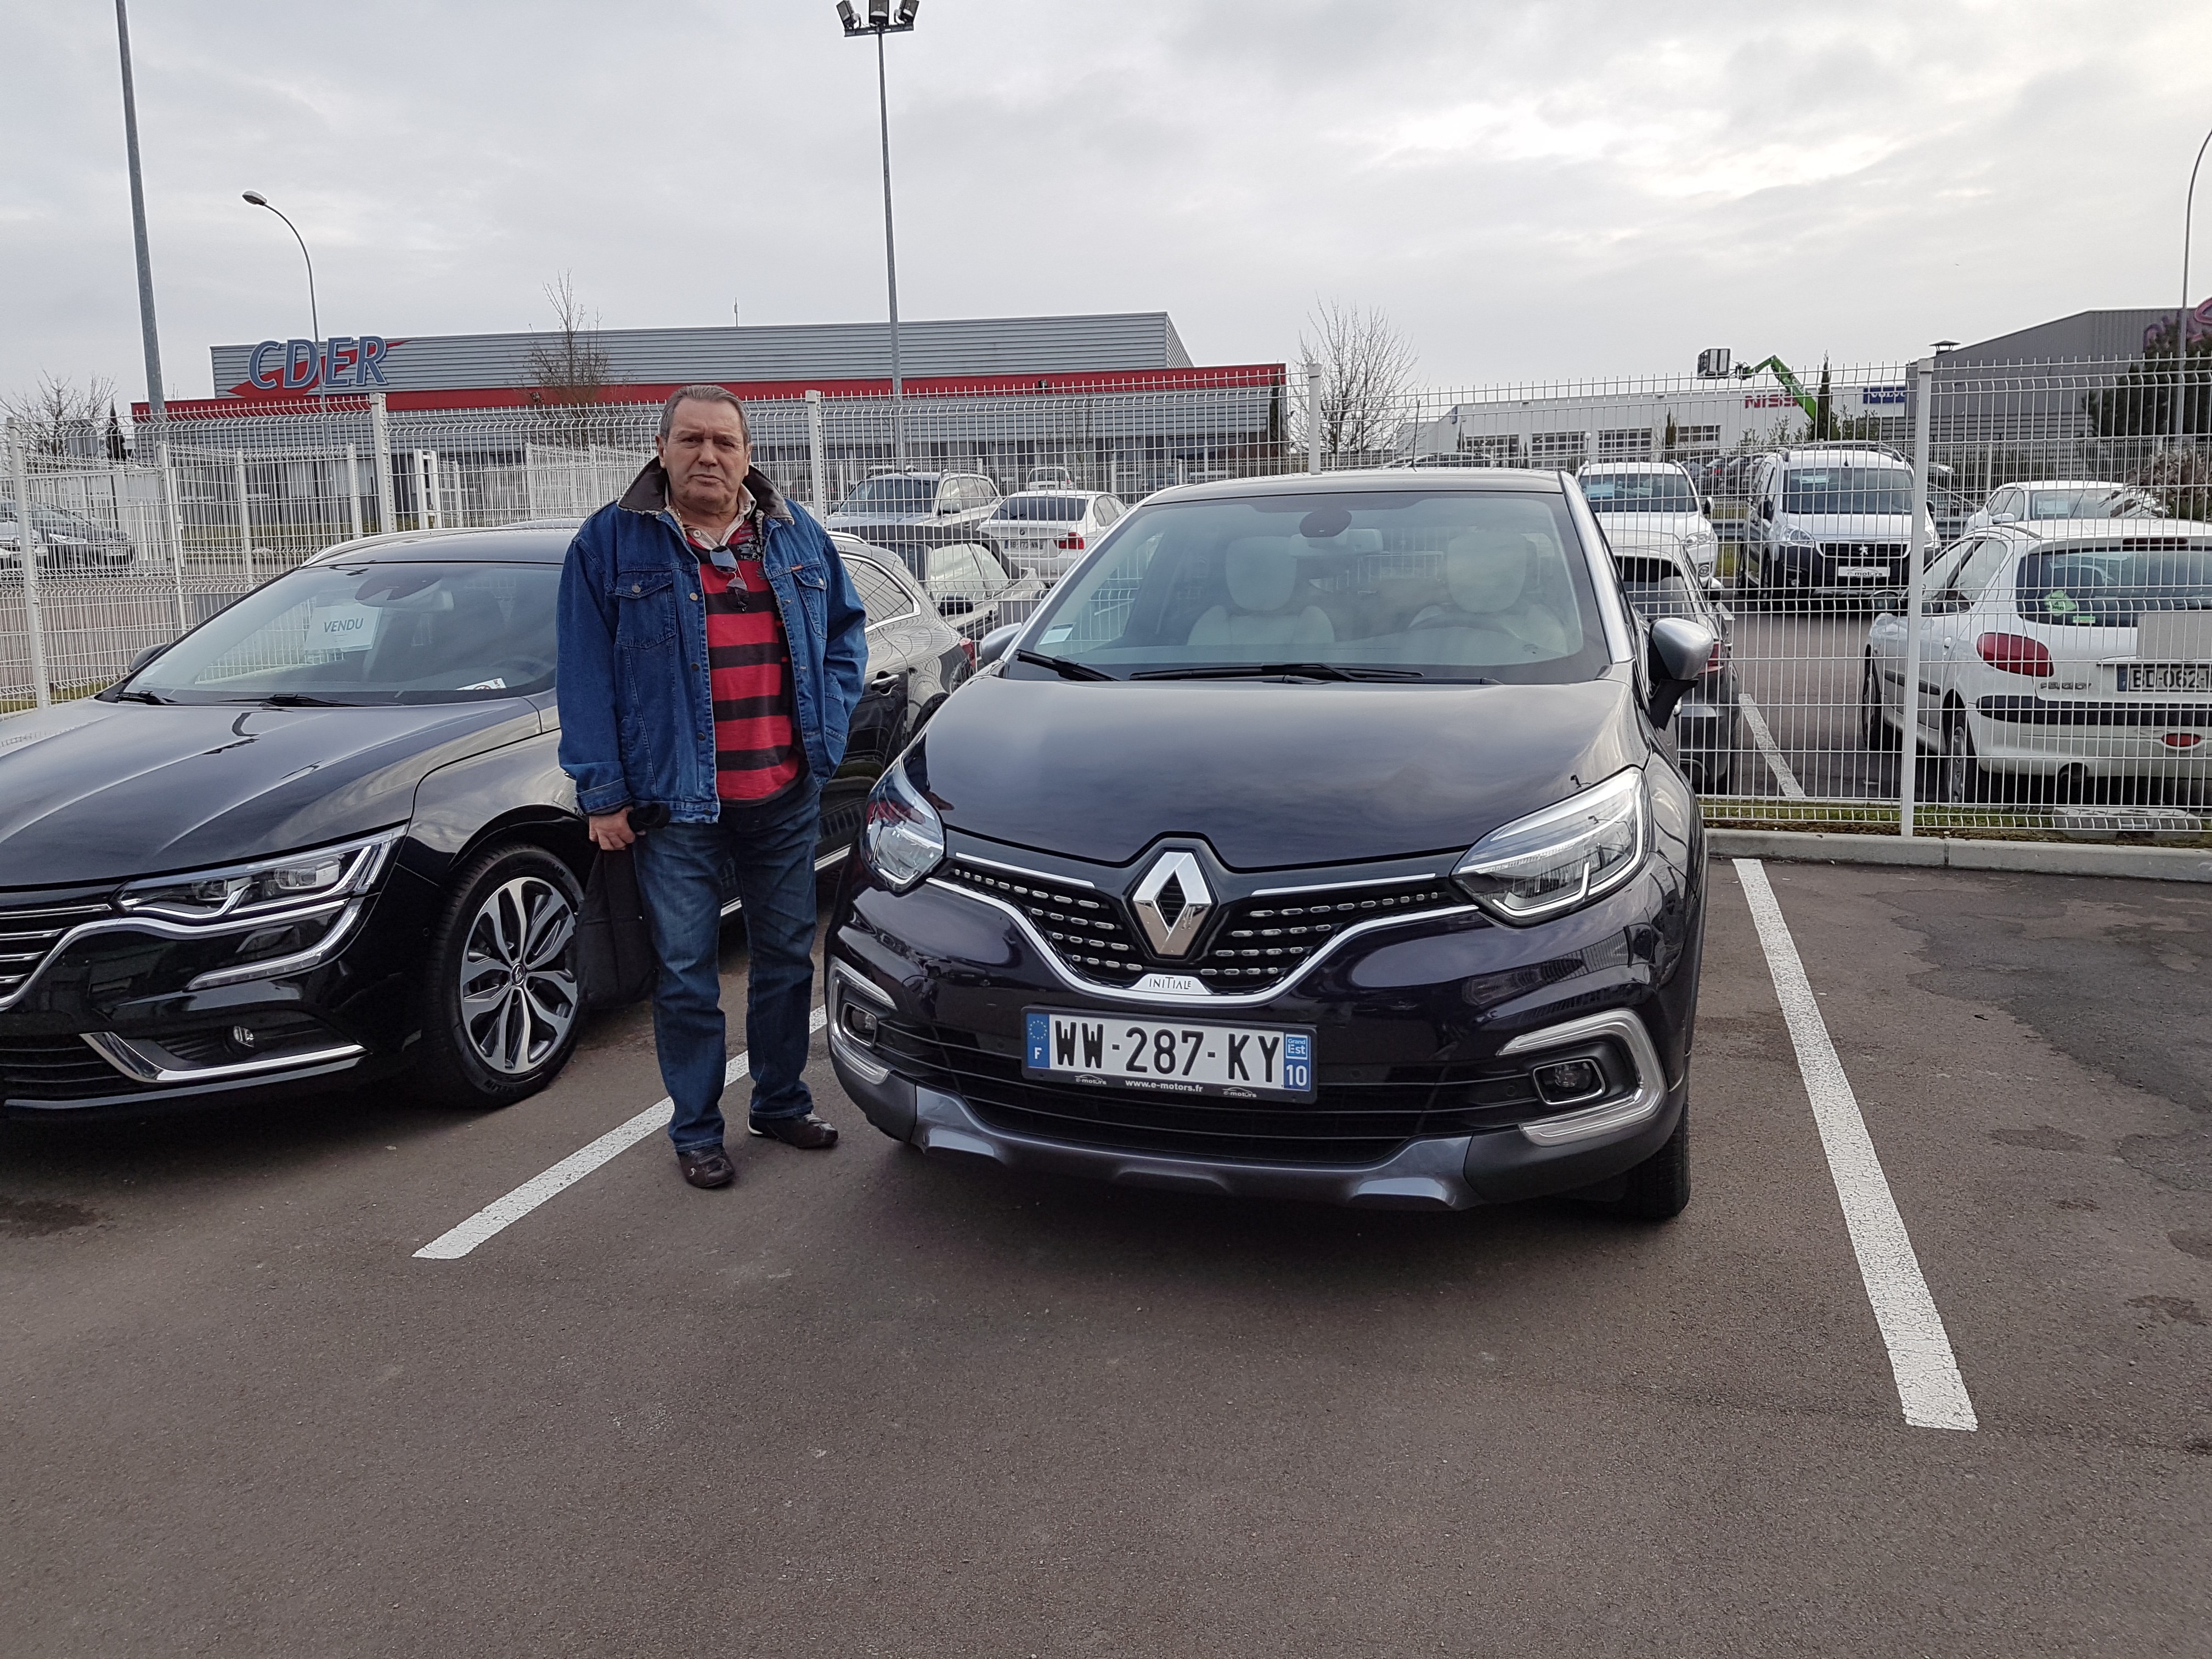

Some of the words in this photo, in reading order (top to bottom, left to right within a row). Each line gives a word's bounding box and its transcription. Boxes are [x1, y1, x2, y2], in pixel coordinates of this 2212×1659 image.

[249, 335, 388, 390] CDER
[324, 618, 364, 633] VENDU
[2133, 669, 2212, 689] BD-062-
[1149, 977, 1192, 990] INITIALE
[1034, 1047, 1042, 1059] F
[1055, 1020, 1280, 1083] WW-287-KY
[1288, 1044, 1306, 1055] Est
[1286, 1064, 1307, 1086] 10
[1125, 1080, 1203, 1092] www.e-motors.fr
